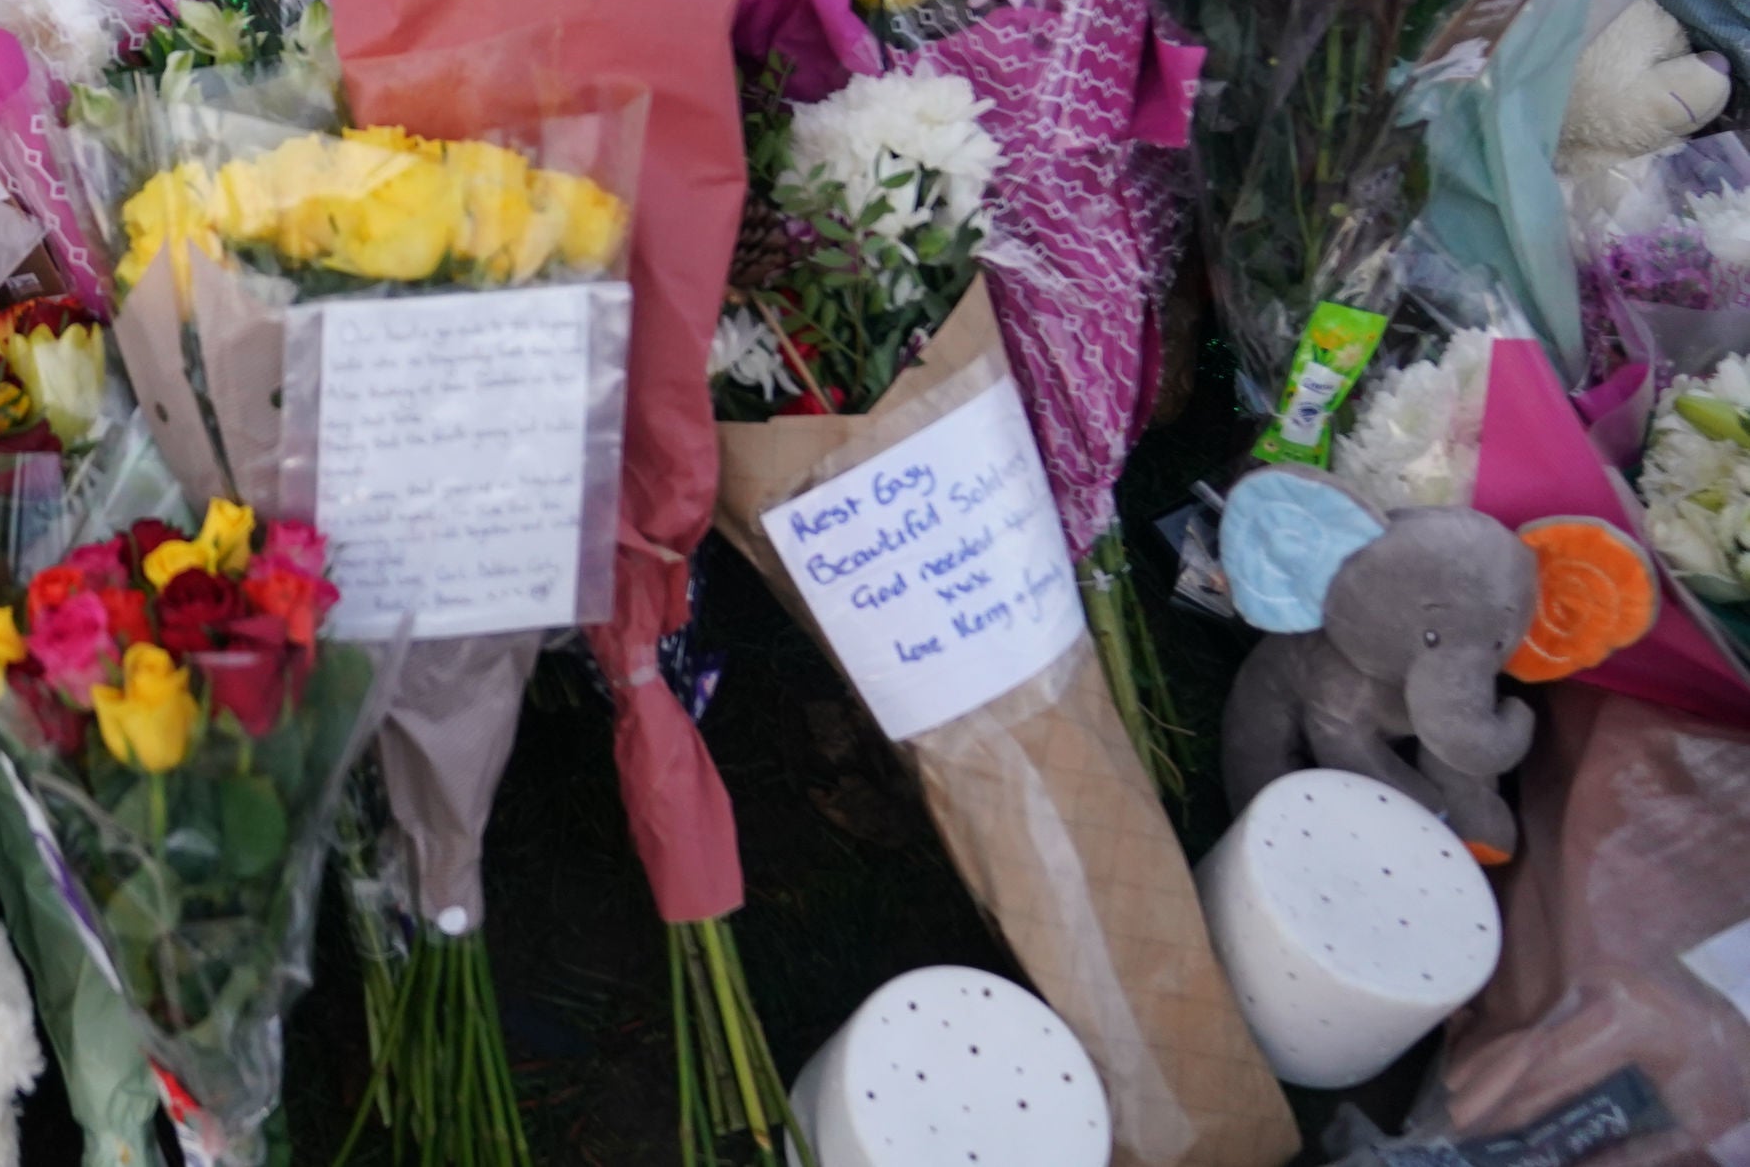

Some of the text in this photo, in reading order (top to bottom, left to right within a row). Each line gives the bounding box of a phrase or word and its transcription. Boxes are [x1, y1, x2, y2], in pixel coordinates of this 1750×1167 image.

[789, 497, 861, 544] Rest
[806, 501, 943, 585] Beautiful
[851, 571, 908, 611] God
